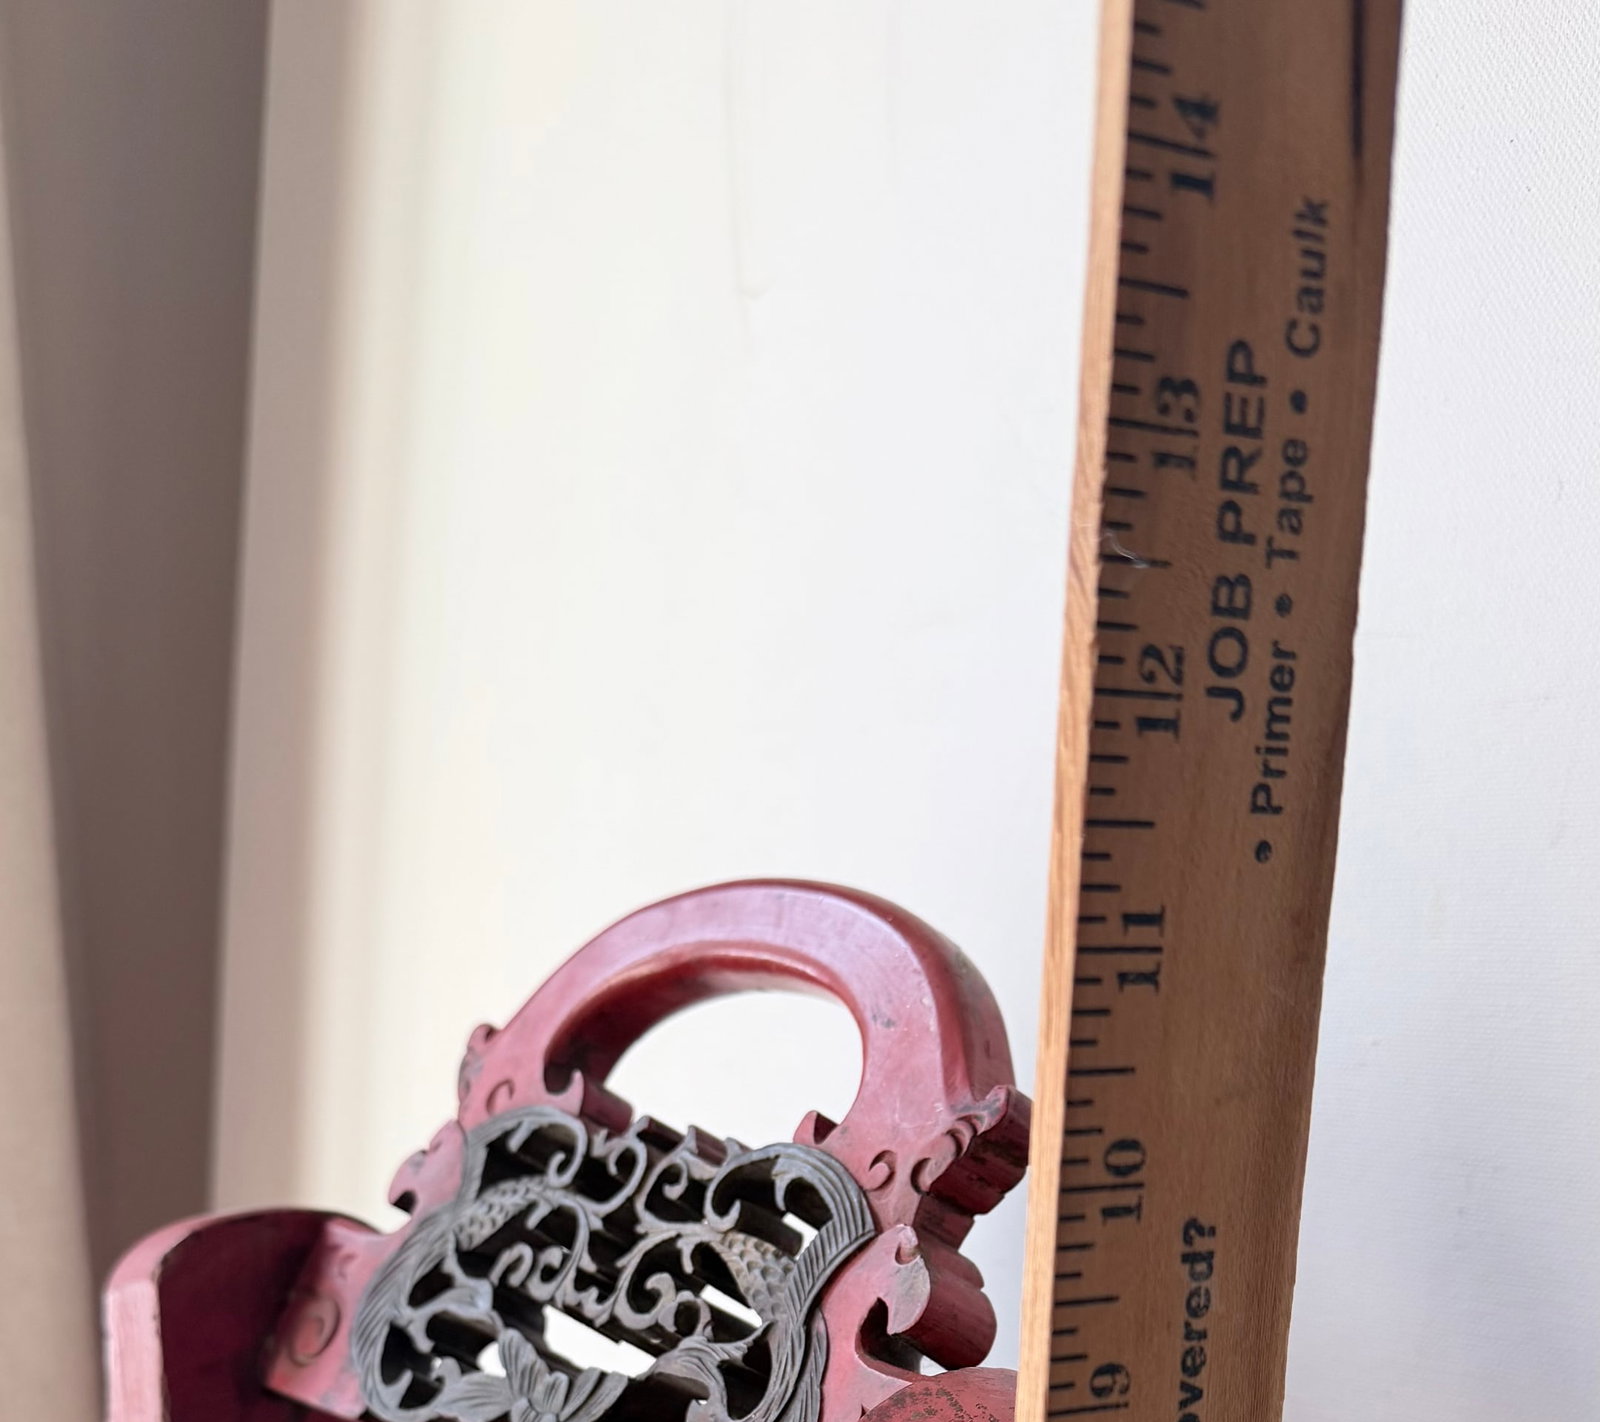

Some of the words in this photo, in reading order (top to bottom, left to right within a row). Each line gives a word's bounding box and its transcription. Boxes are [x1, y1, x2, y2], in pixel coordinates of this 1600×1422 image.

[1171, 94, 1218, 199] 14
[1285, 196, 1329, 358] Caulk
[1152, 376, 1199, 478] 13
[1217, 339, 1267, 546] PREP
[1266, 437, 1314, 568] Tape
[1136, 644, 1185, 742] 12
[1206, 573, 1253, 722] JOB
[1250, 640, 1298, 816] Primer
[1117, 905, 1165, 995] 11
[1101, 1138, 1146, 1224] 10
[1090, 1362, 1130, 1398] 9
